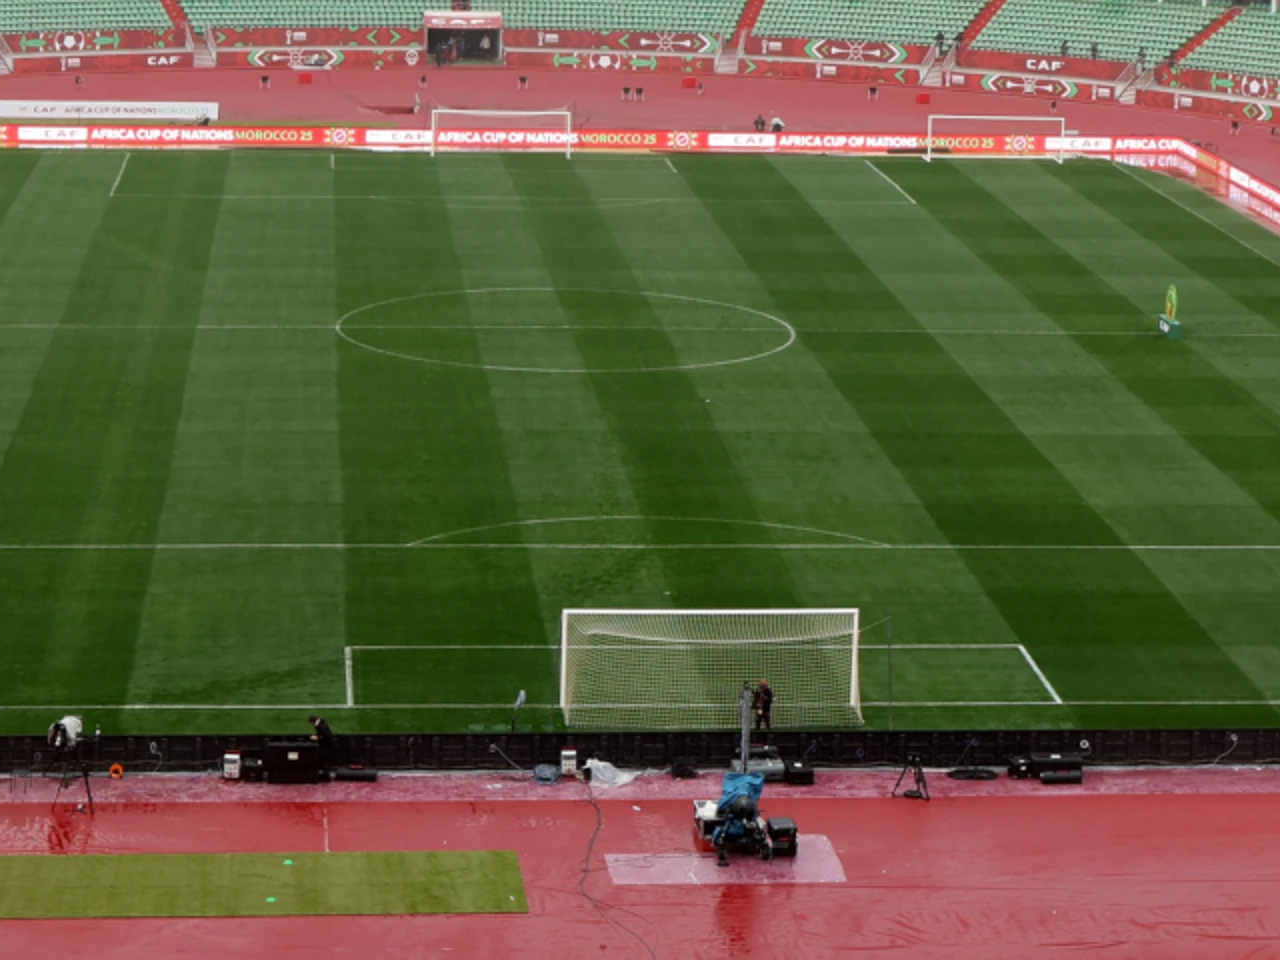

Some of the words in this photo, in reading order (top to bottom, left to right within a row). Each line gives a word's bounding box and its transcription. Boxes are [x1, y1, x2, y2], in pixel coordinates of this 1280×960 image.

[148, 56, 178, 65] CAF
[1025, 59, 1061, 71] CAF
[45, 130, 79, 138] CAF
[91, 129, 135, 140] AFRICA
[136, 129, 160, 140] CUP
[162, 130, 180, 140] OF
[181, 130, 234, 141] NATIONS
[235, 130, 298, 141] MOROCCO
[299, 131, 313, 141] 25
[438, 132, 481, 142] AFRICA
[482, 132, 506, 142] CUP
[508, 132, 525, 143] OF
[526, 132, 578, 143] NATIONS
[580, 134, 642, 144] MOROCCO
[643, 134, 656, 144] 25
[733, 136, 766, 144] CAF
[780, 135, 822, 146] AFRICA
[823, 136, 847, 146] CUP
[848, 136, 865, 147] OF
[866, 136, 918, 147] NATIONS
[919, 137, 980, 148] MOROCCO
[981, 138, 994, 148] 25
[1115, 138, 1157, 149] AFRICA
